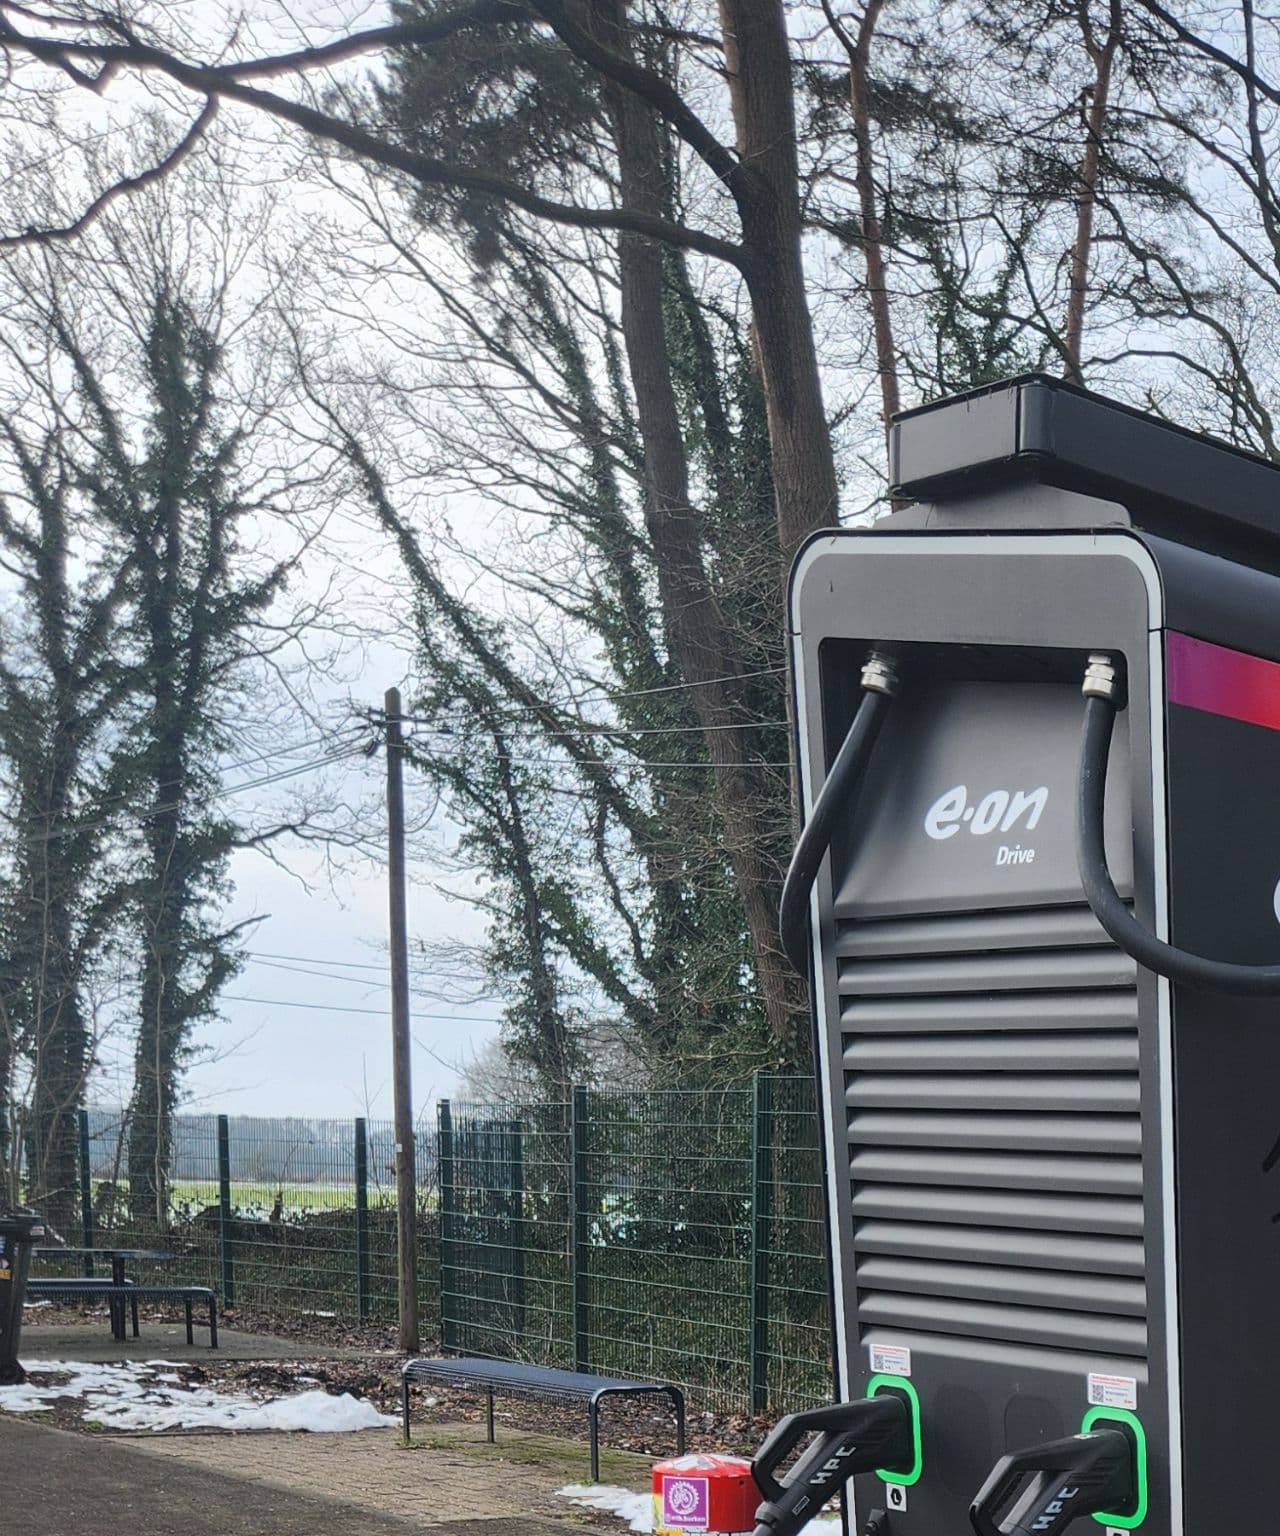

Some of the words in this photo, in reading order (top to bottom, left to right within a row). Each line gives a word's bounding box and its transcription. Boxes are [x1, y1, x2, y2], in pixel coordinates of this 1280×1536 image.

[995, 845, 1035, 865] Drive
[810, 1446, 856, 1485] HPC
[1031, 1487, 1079, 1530] HPC
